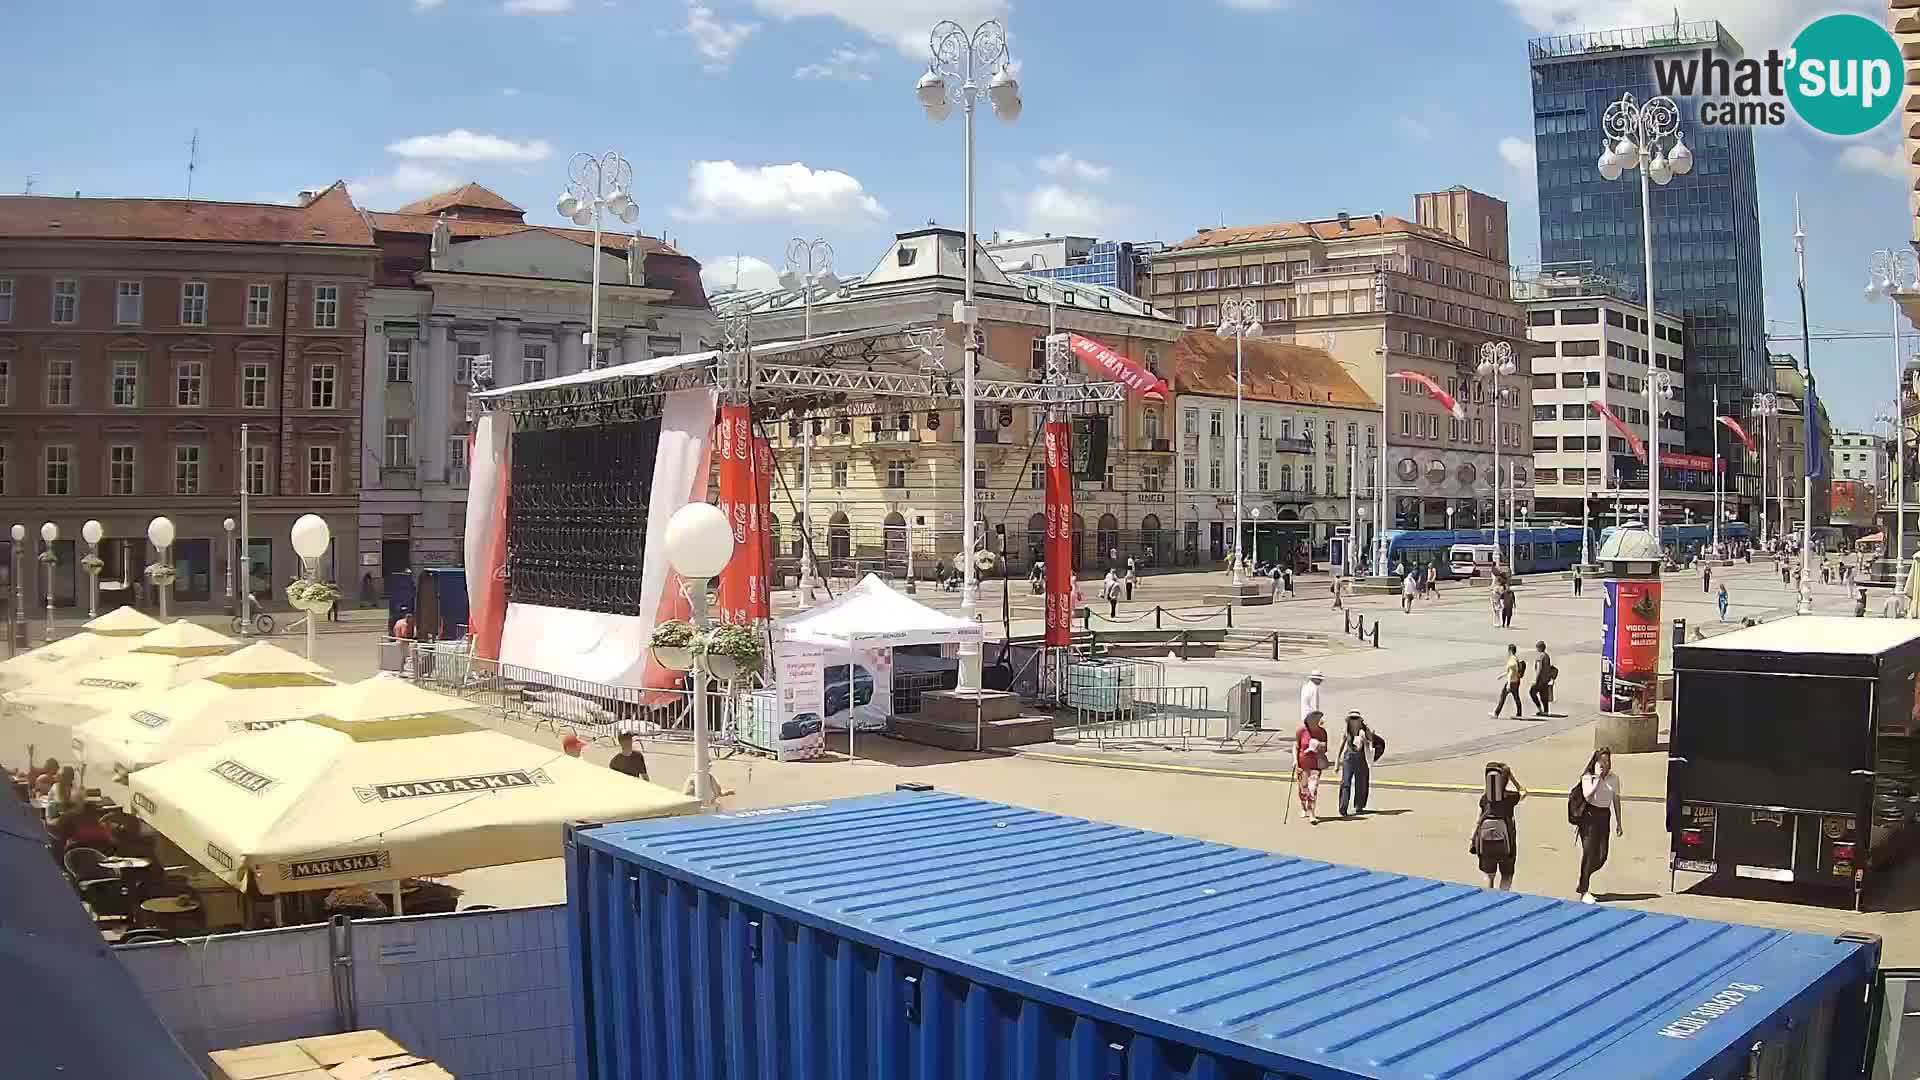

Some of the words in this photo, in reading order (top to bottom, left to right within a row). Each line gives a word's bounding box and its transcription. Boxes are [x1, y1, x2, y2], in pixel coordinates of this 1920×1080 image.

[735, 417, 747, 460] Coca-Cola
[1046, 431, 1057, 468] Coca-Cola
[734, 499, 746, 543] Coca-Cola
[1047, 503, 1056, 538] Coca-Cola
[1060, 503, 1069, 538] Coca-Cola
[385, 773, 523, 799] MARASKA
[295, 855, 376, 876] MARASKA
